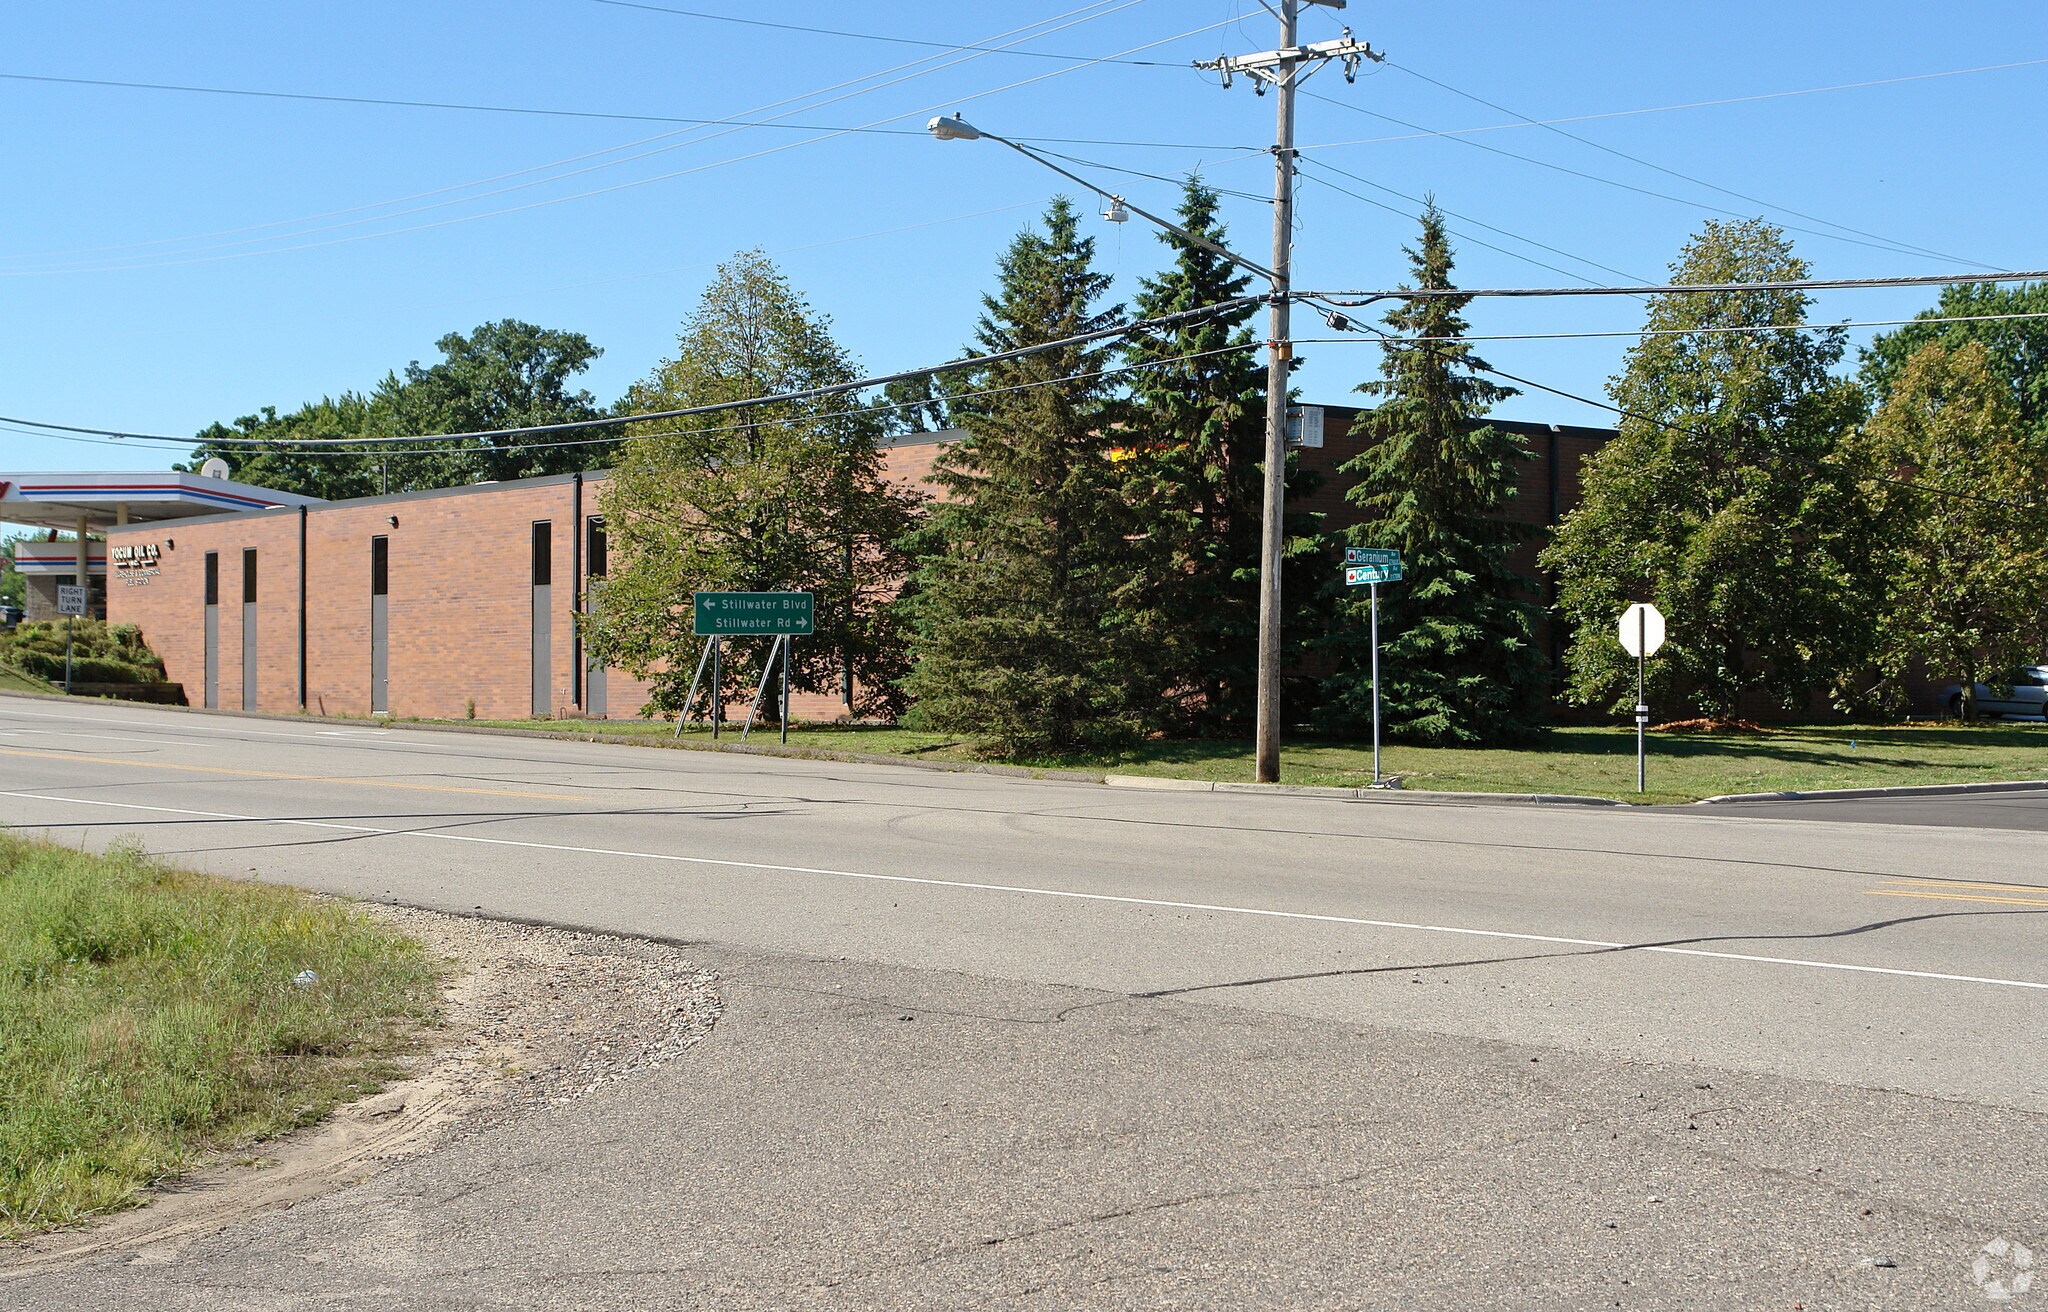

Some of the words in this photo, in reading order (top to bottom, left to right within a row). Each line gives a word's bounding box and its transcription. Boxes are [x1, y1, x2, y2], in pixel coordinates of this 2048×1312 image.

[111, 546, 133, 559] YOCUM
[134, 545, 146, 558] OIL
[1356, 550, 1389, 563] Geranium
[1356, 569, 1389, 581] Century
[60, 587, 83, 595] RIGHT
[60, 605, 82, 613] LANE
[721, 599, 777, 610] Stillwater
[782, 599, 807, 610] Blvd
[715, 617, 771, 628] Stillwater
[777, 617, 791, 628] Rd
